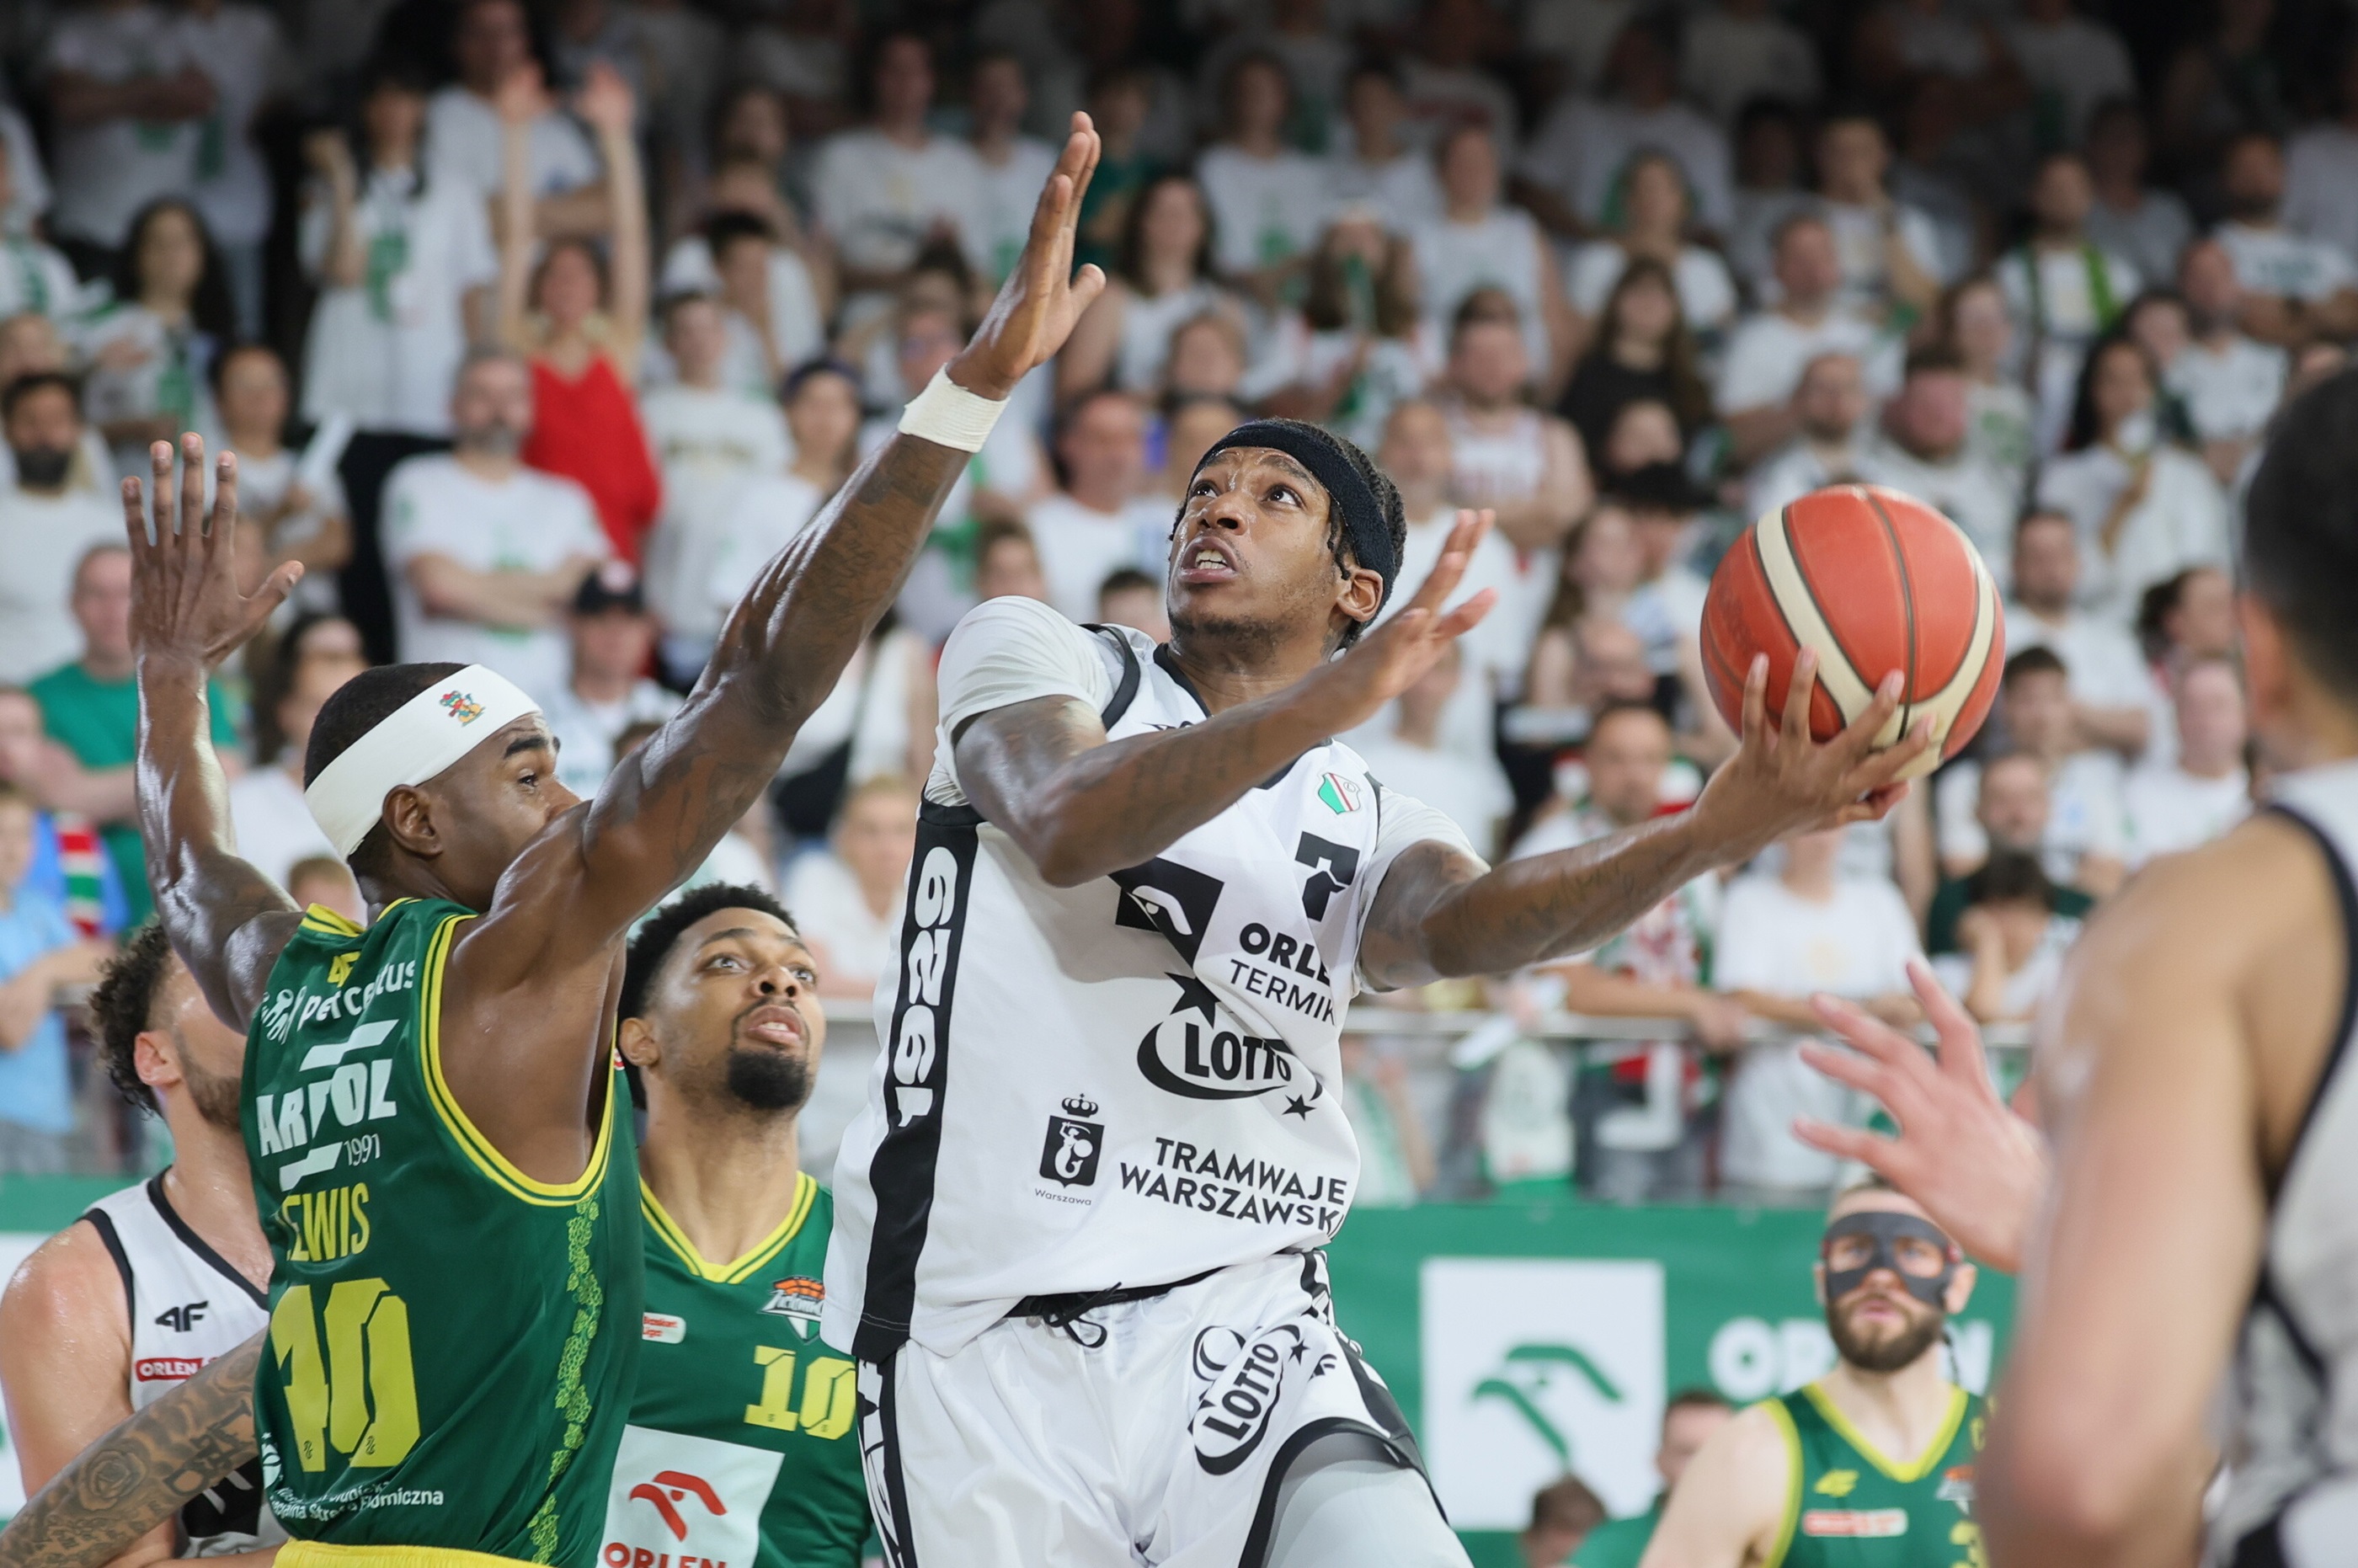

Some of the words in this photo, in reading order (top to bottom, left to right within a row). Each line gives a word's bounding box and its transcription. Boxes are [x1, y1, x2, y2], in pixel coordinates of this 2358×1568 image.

[1184, 1021, 1292, 1082] LOTTO
[343, 1133, 381, 1166] 1991
[1155, 1136, 1347, 1206] TRAMWAJE
[281, 1182, 371, 1261] EWIS
[1034, 1187, 1093, 1207] Warszawa
[155, 1299, 209, 1333] 4F
[139, 1361, 200, 1378] ORLEN
[269, 1277, 421, 1473] 10
[743, 1345, 856, 1441] 10
[1202, 1343, 1279, 1442] LOTTO
